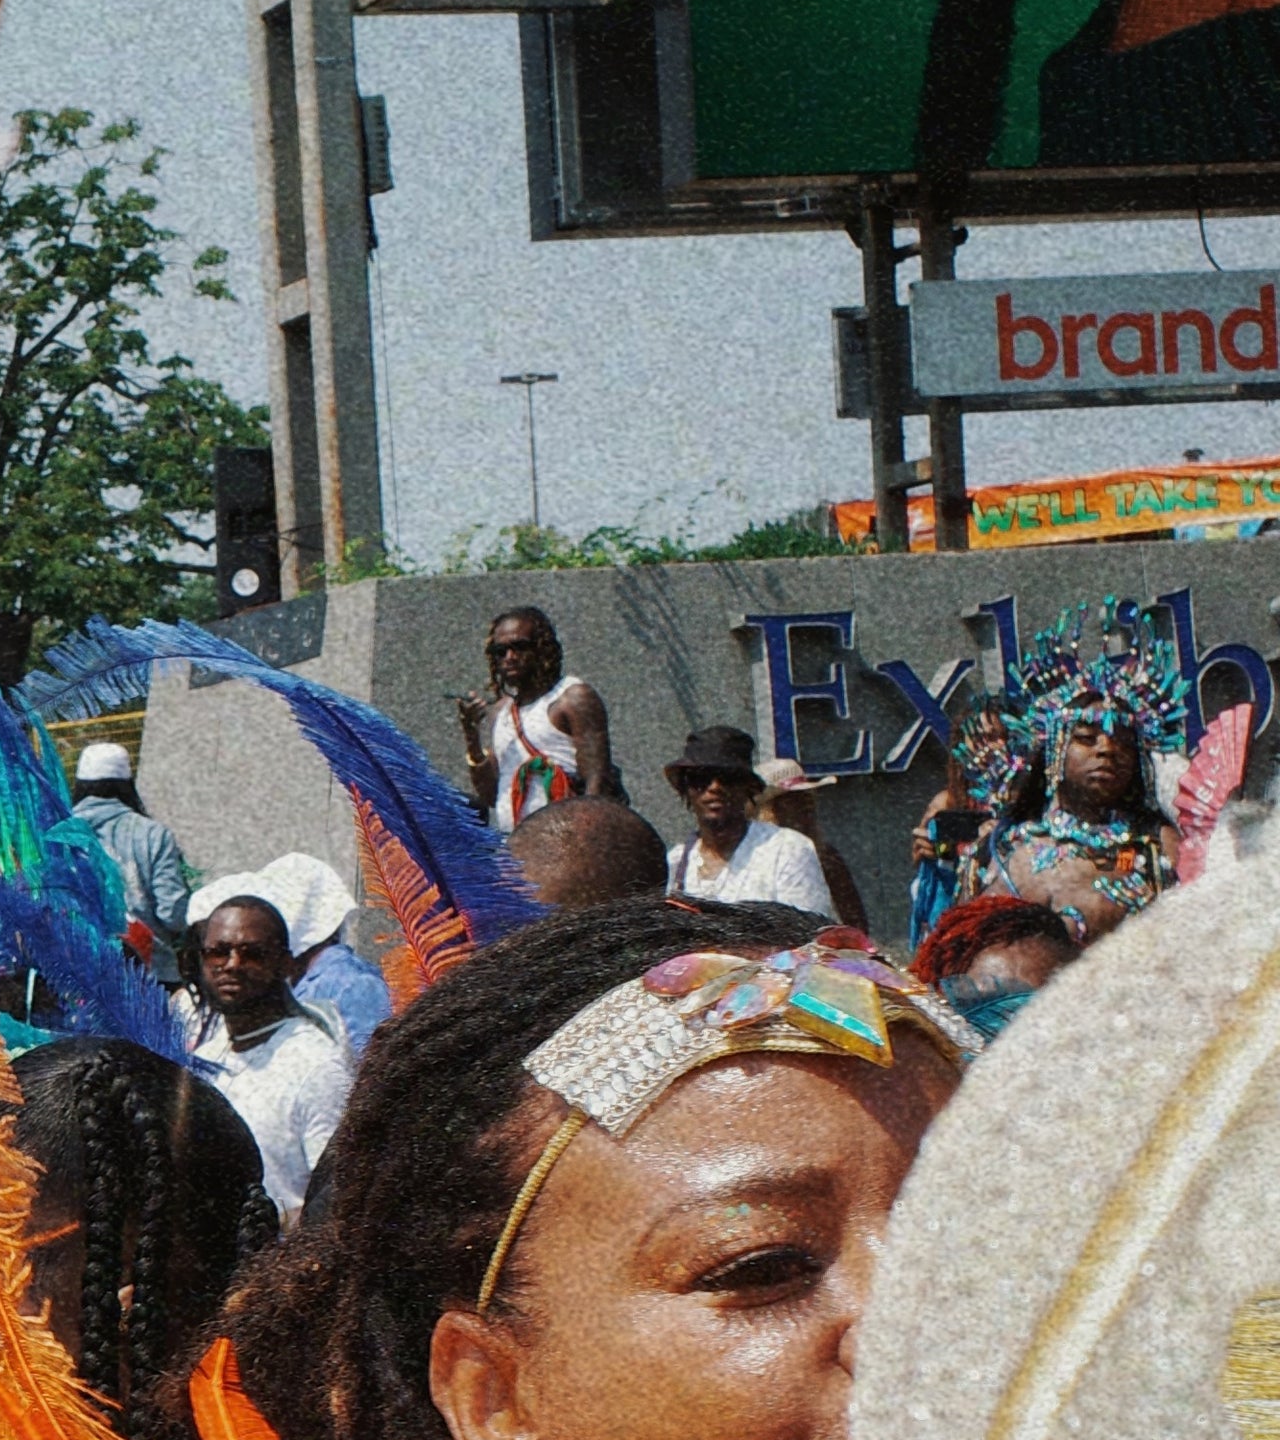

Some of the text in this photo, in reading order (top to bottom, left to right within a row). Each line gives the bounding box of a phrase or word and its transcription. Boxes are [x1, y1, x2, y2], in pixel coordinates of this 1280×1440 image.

[994, 282, 1278, 382] brand
[971, 487, 1101, 535] WE'LL
[1105, 474, 1220, 519] TAKE
